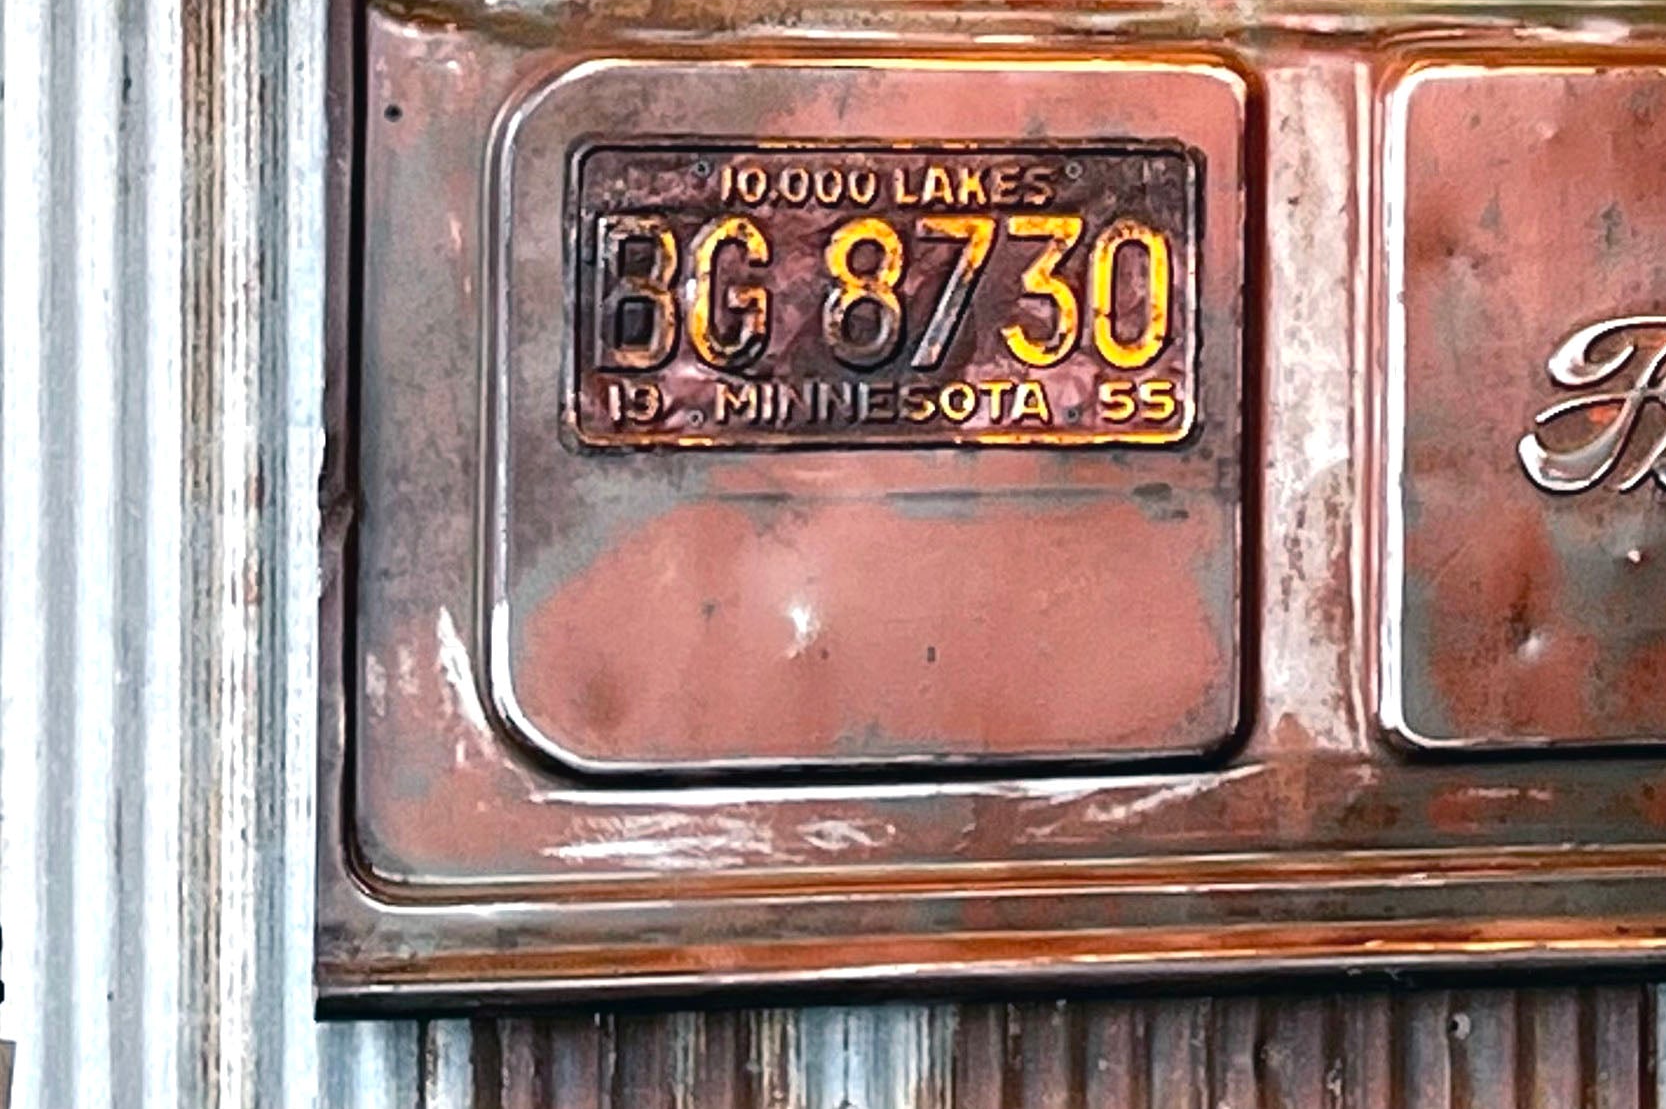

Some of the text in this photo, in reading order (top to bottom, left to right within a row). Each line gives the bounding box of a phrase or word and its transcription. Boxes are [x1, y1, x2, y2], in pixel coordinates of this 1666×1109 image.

[894, 165, 1055, 208] LAKES
[597, 215, 1174, 374] BG 8730
[713, 380, 1052, 426] MINNESOTA
